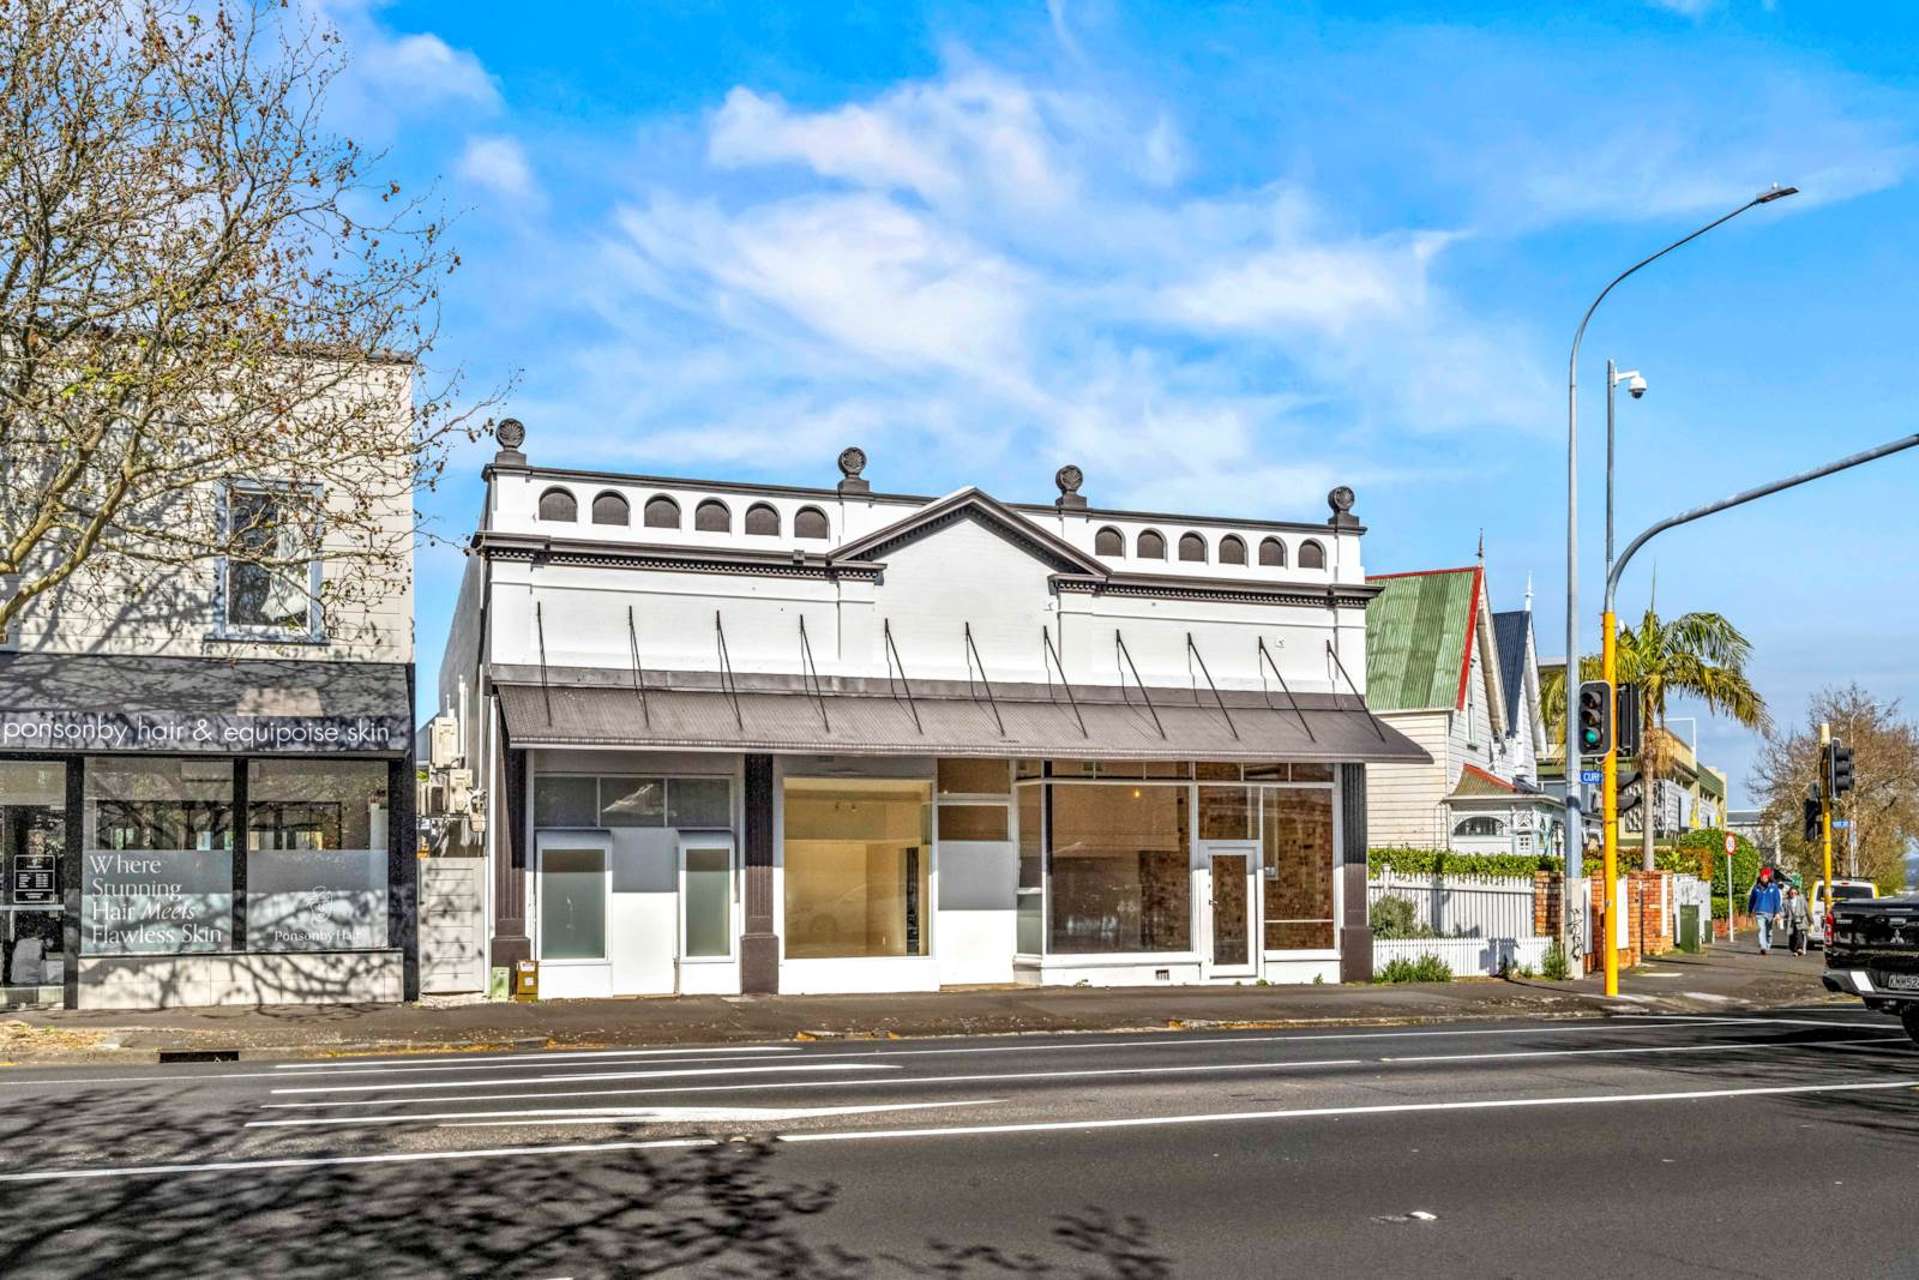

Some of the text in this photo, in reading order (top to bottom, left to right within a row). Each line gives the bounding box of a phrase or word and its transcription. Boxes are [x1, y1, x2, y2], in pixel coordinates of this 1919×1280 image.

[4, 714, 390, 748] ponsonby hair & equipoise skin
[90, 854, 162, 874] Where
[92, 878, 182, 900] Stunning
[93, 901, 196, 920] Hair Meets
[92, 923, 222, 944] Flawless Skin
